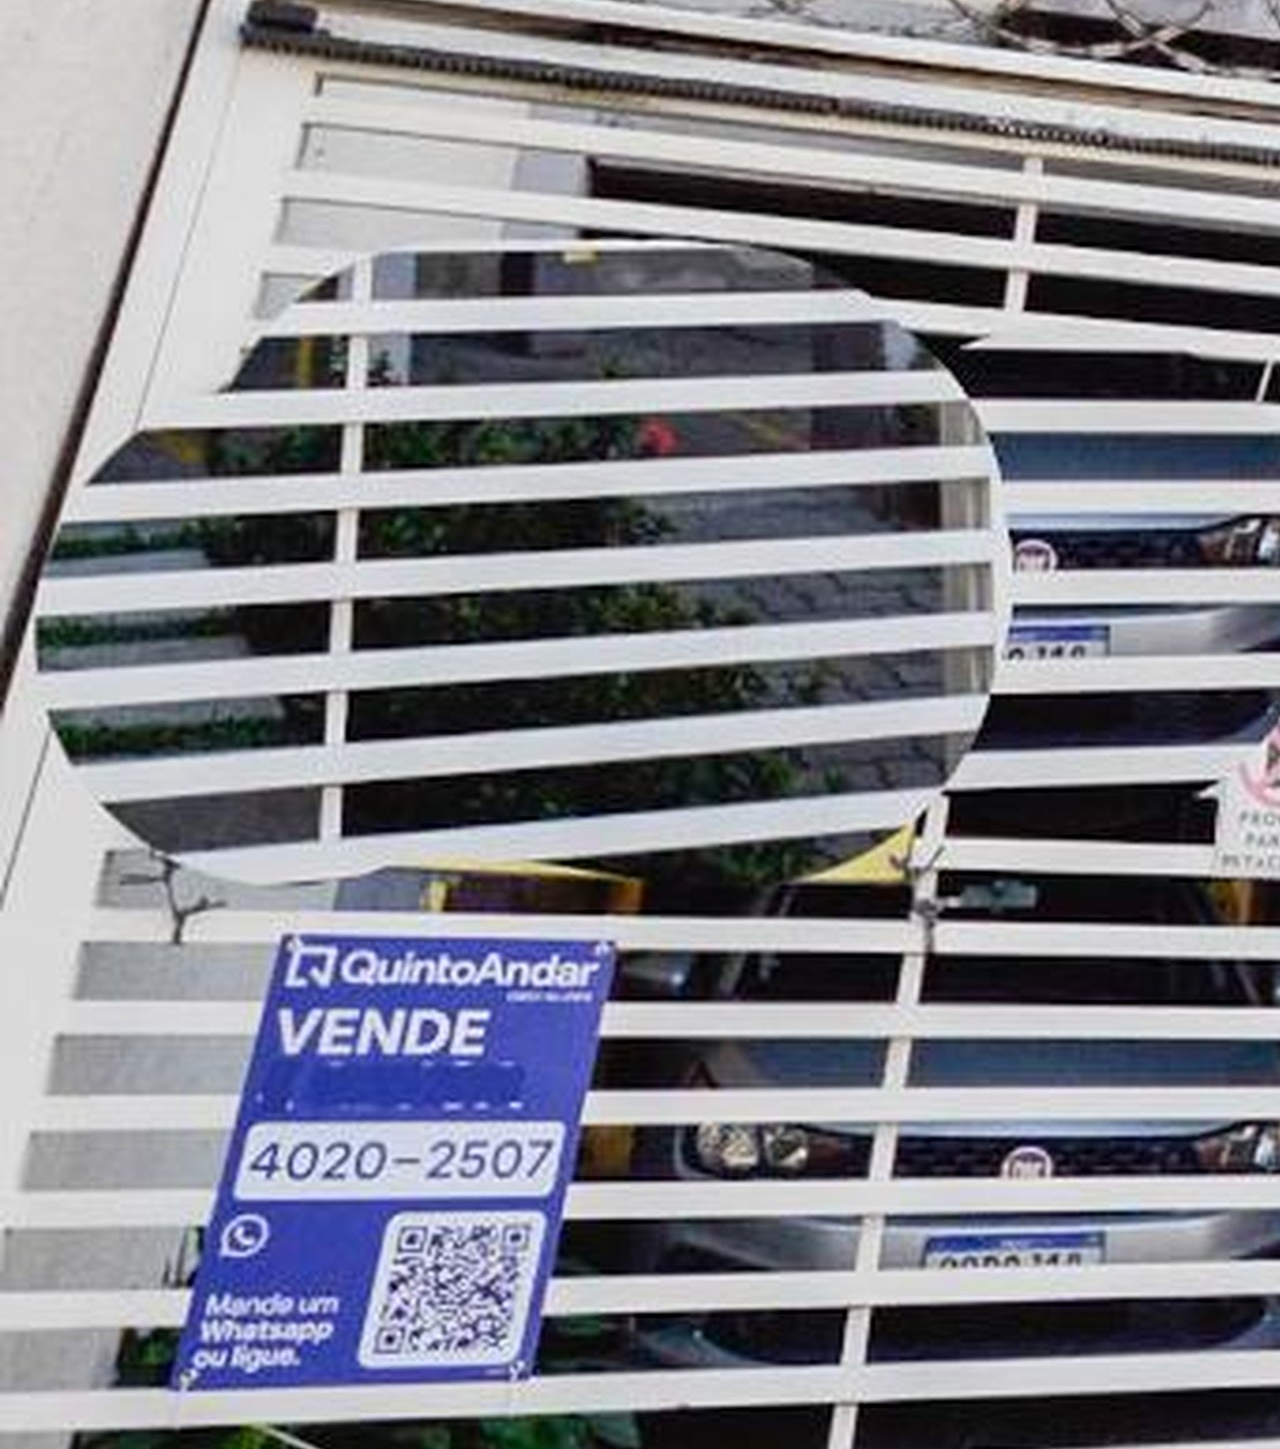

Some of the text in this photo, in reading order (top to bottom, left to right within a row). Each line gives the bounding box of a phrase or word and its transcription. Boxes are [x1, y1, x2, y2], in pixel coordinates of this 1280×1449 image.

[341, 949, 600, 988] QuintoAndar
[278, 1008, 491, 1056] VENDE
[249, 1140, 554, 1181] 4020-2507
[205, 1293, 339, 1317] Mande um
[200, 1319, 335, 1346] Whatsapp
[192, 1344, 301, 1374] ou ligue.
